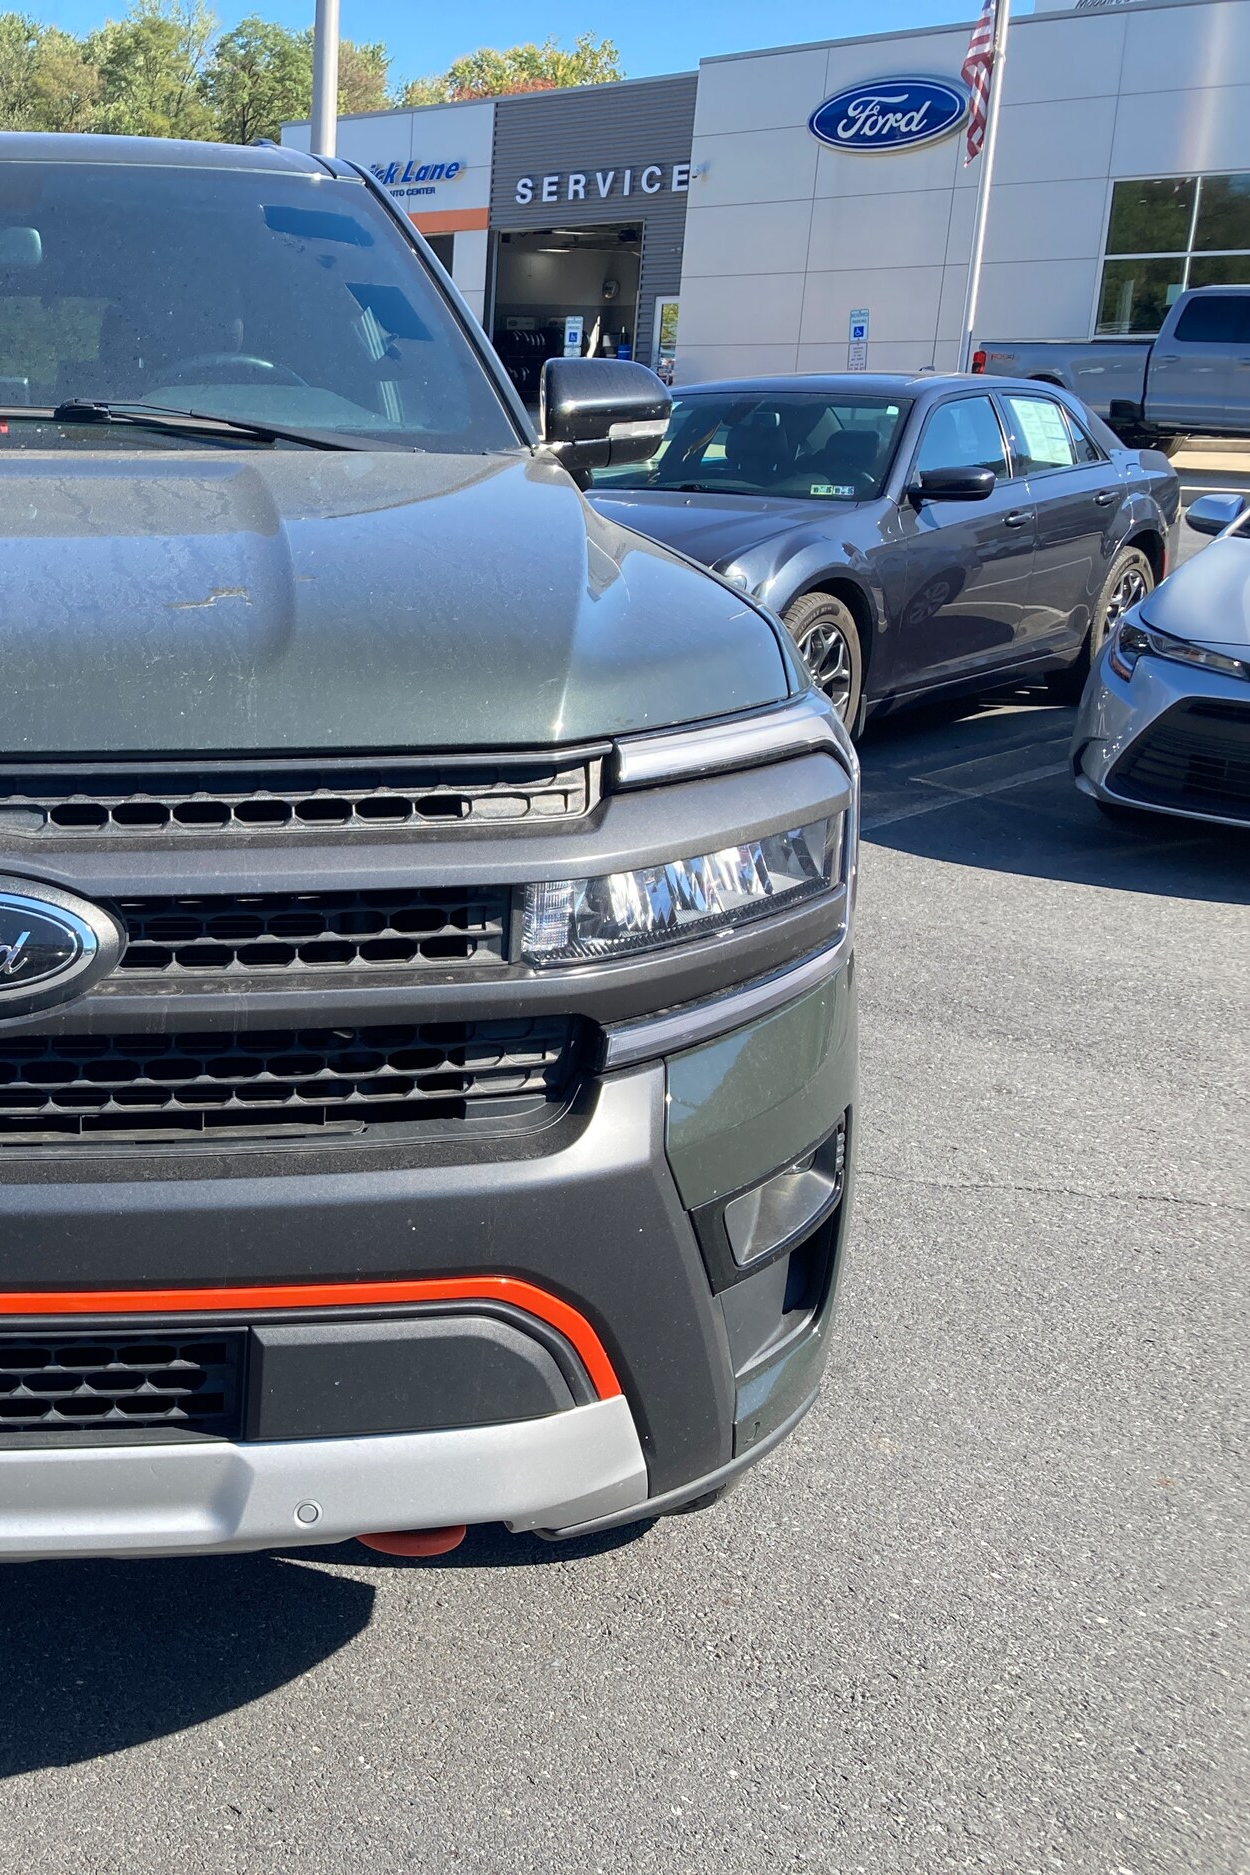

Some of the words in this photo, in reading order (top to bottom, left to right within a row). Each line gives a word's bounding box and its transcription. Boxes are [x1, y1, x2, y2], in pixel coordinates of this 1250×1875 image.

[837, 93, 932, 139] Ford
[401, 160, 460, 183] Lane
[515, 164, 691, 205] SERVICE
[389, 189, 405, 198] UTO
[406, 186, 436, 197] CENTER
